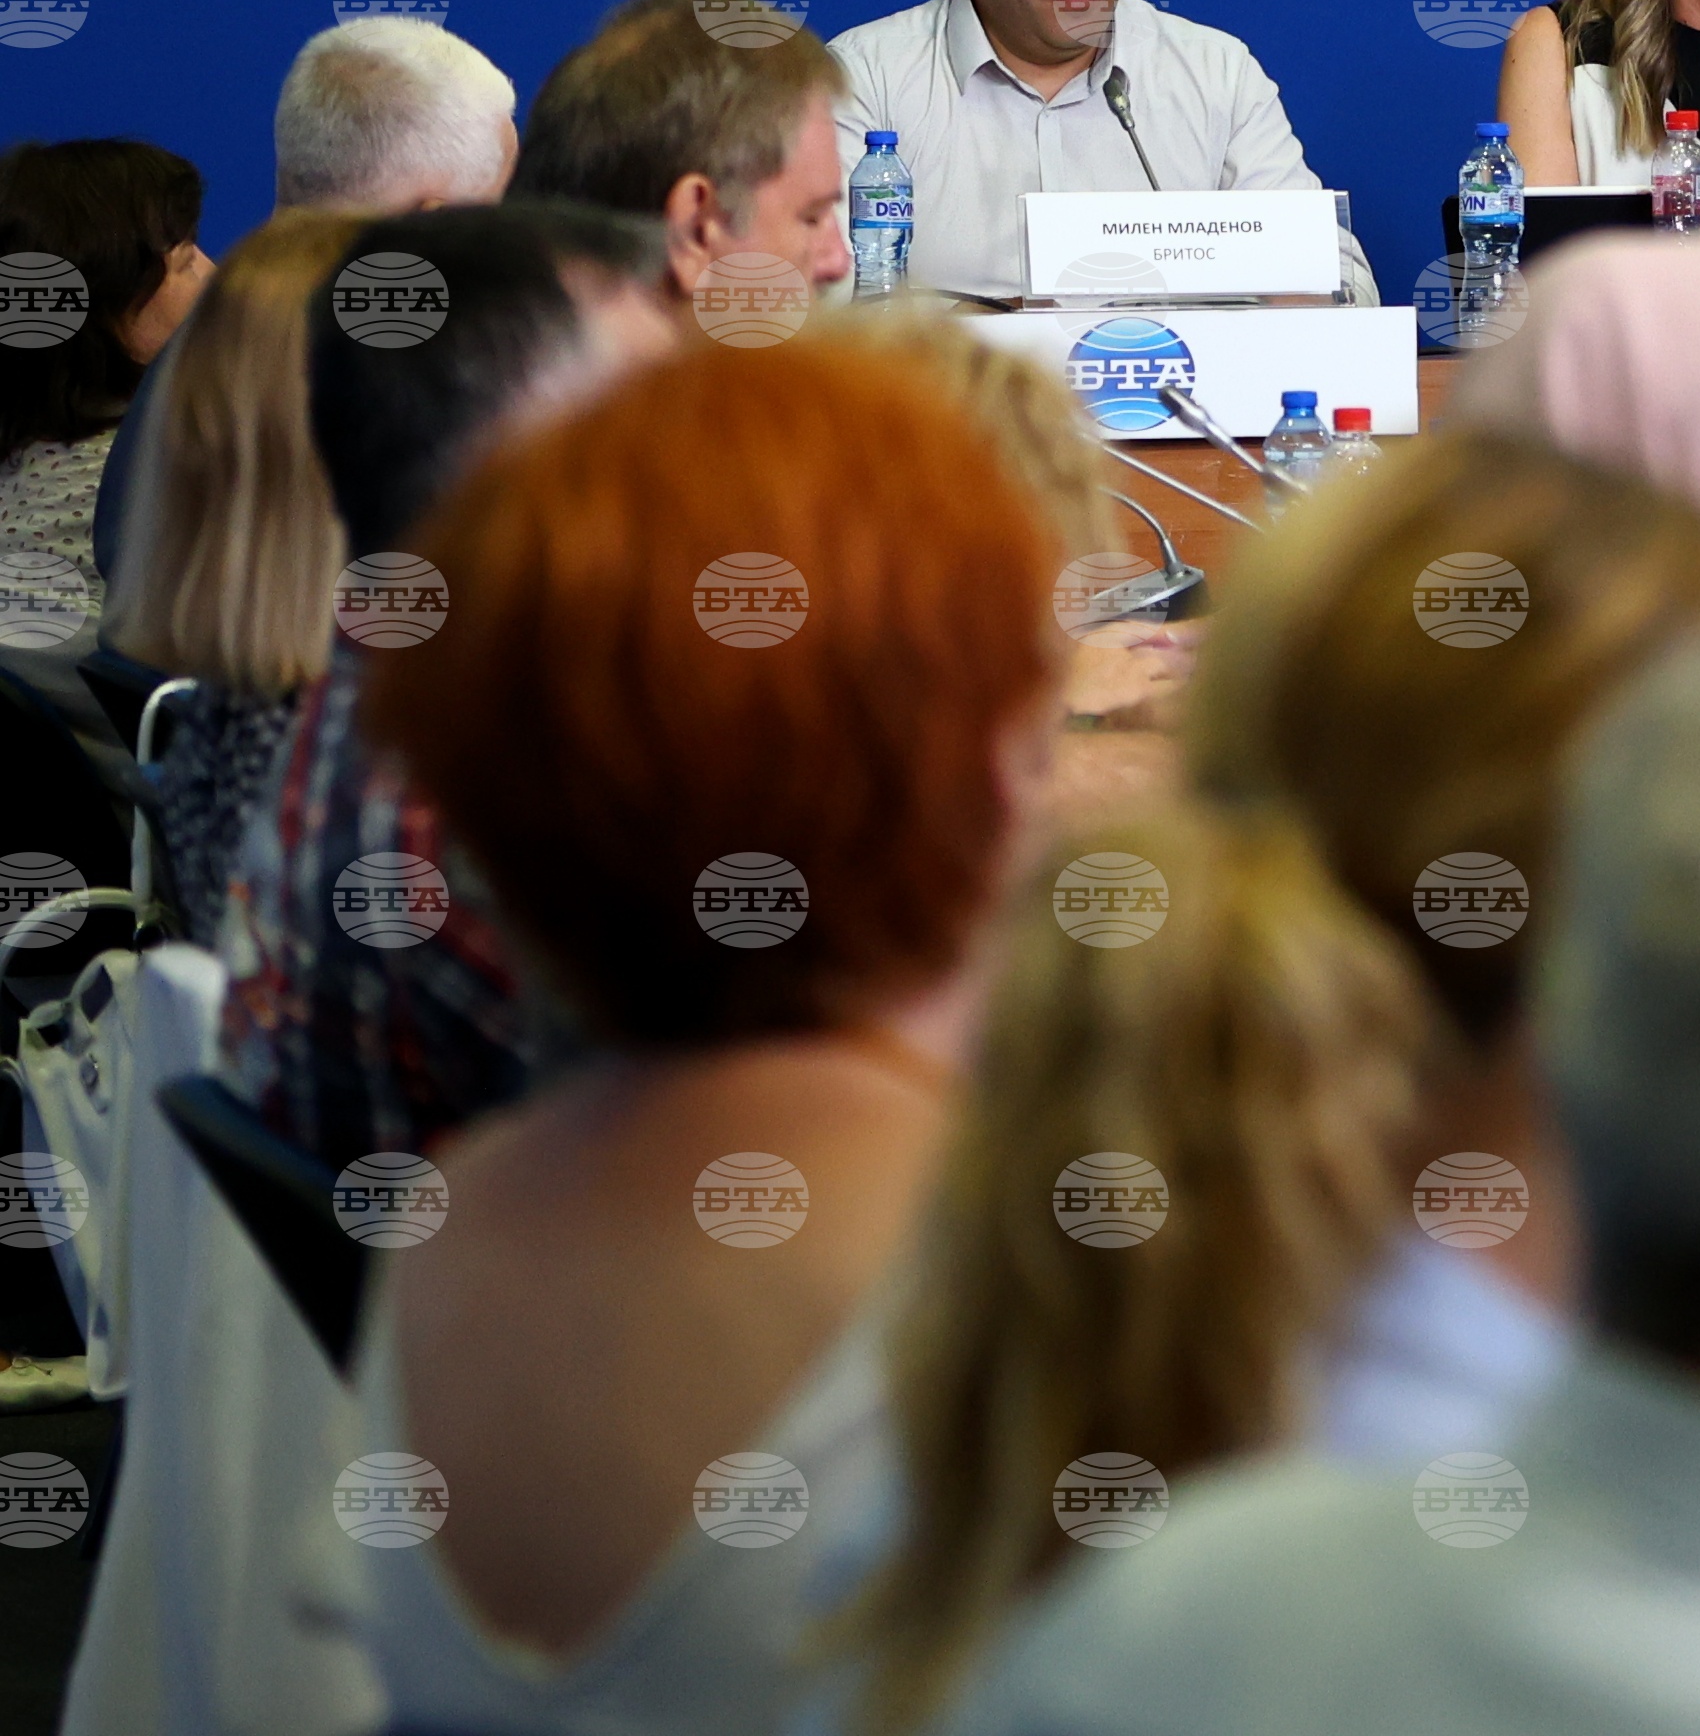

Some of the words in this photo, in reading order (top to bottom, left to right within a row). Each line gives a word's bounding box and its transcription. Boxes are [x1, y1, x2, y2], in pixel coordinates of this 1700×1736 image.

[1102, 222, 1163, 235] МИЛЕН
[1167, 220, 1264, 237] МЛАДЕНОВ
[1153, 246, 1216, 262] БРИТОС
[1070, 358, 1196, 390] БТА
